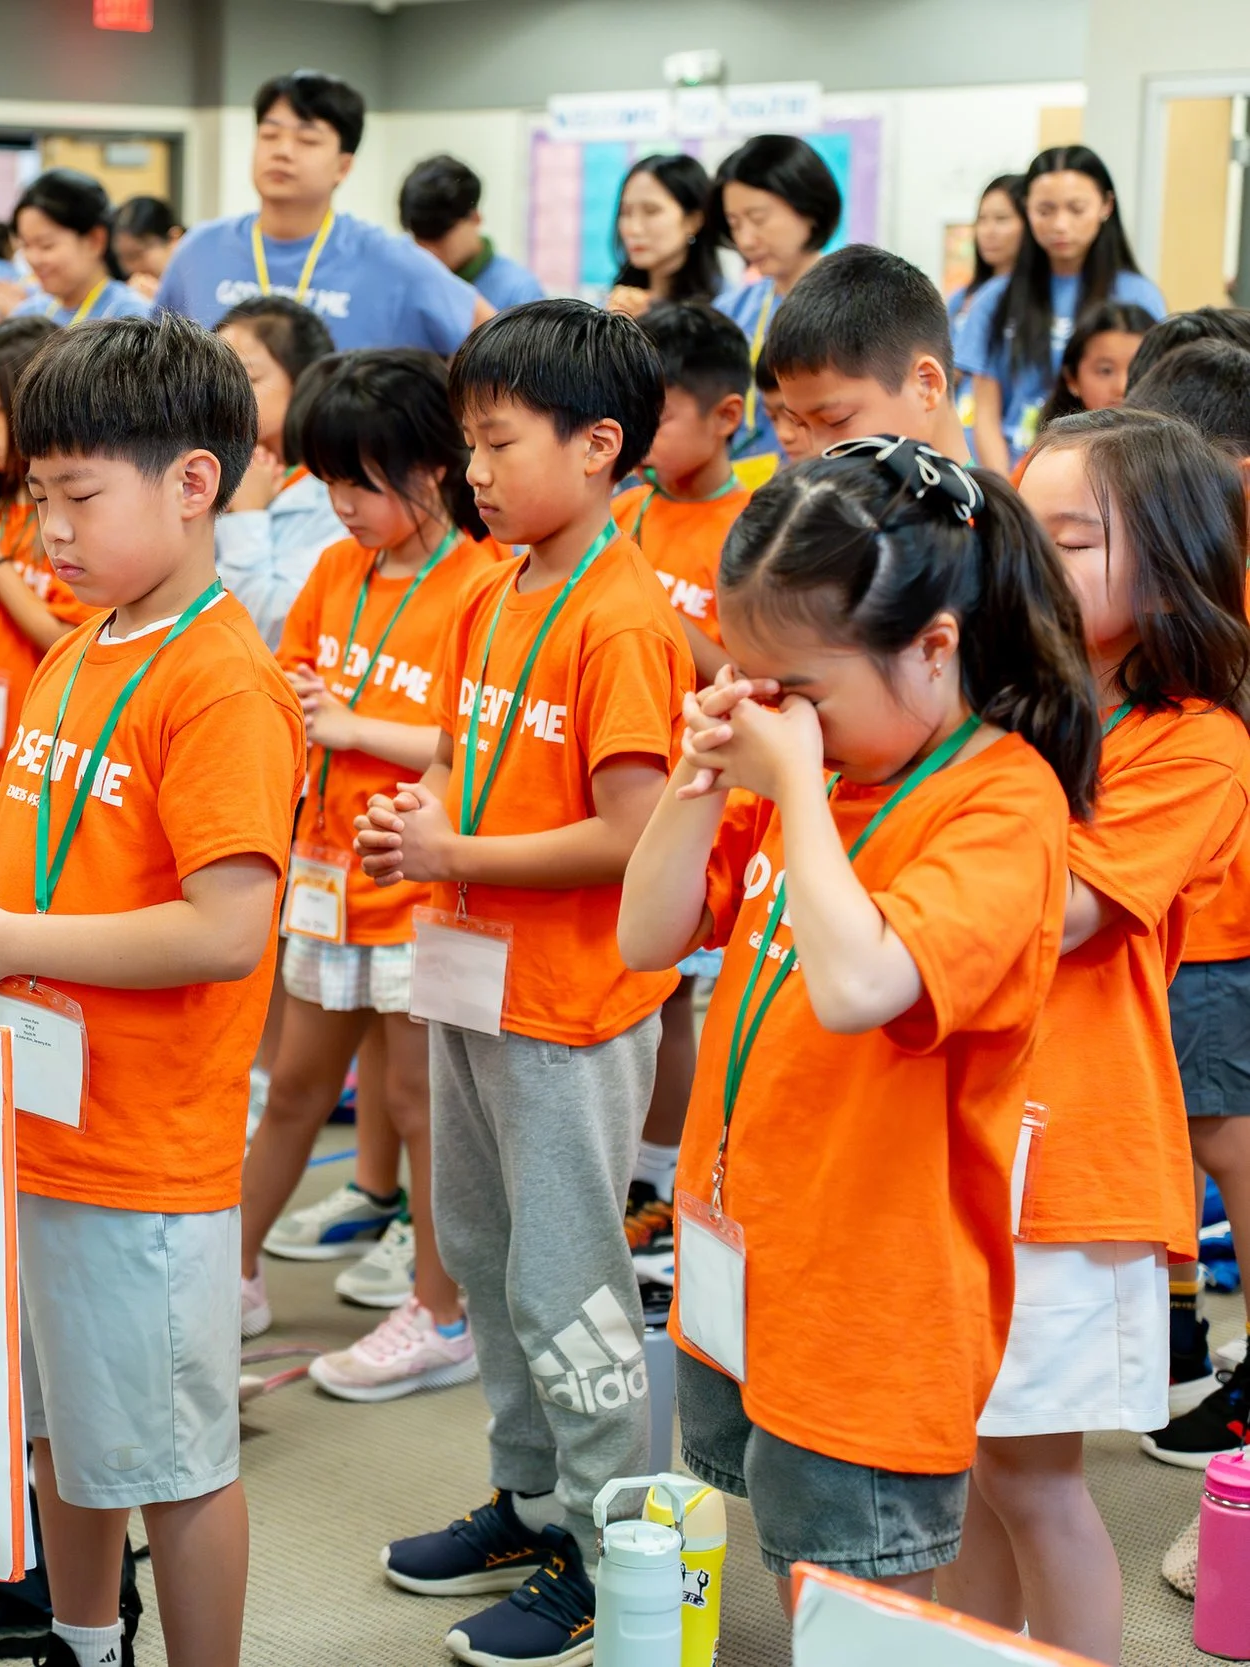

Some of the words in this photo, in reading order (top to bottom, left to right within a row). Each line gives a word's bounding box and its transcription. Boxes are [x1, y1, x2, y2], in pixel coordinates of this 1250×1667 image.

[671, 579, 714, 619] ME
[390, 660, 433, 704] ME
[519, 697, 567, 744] ME
